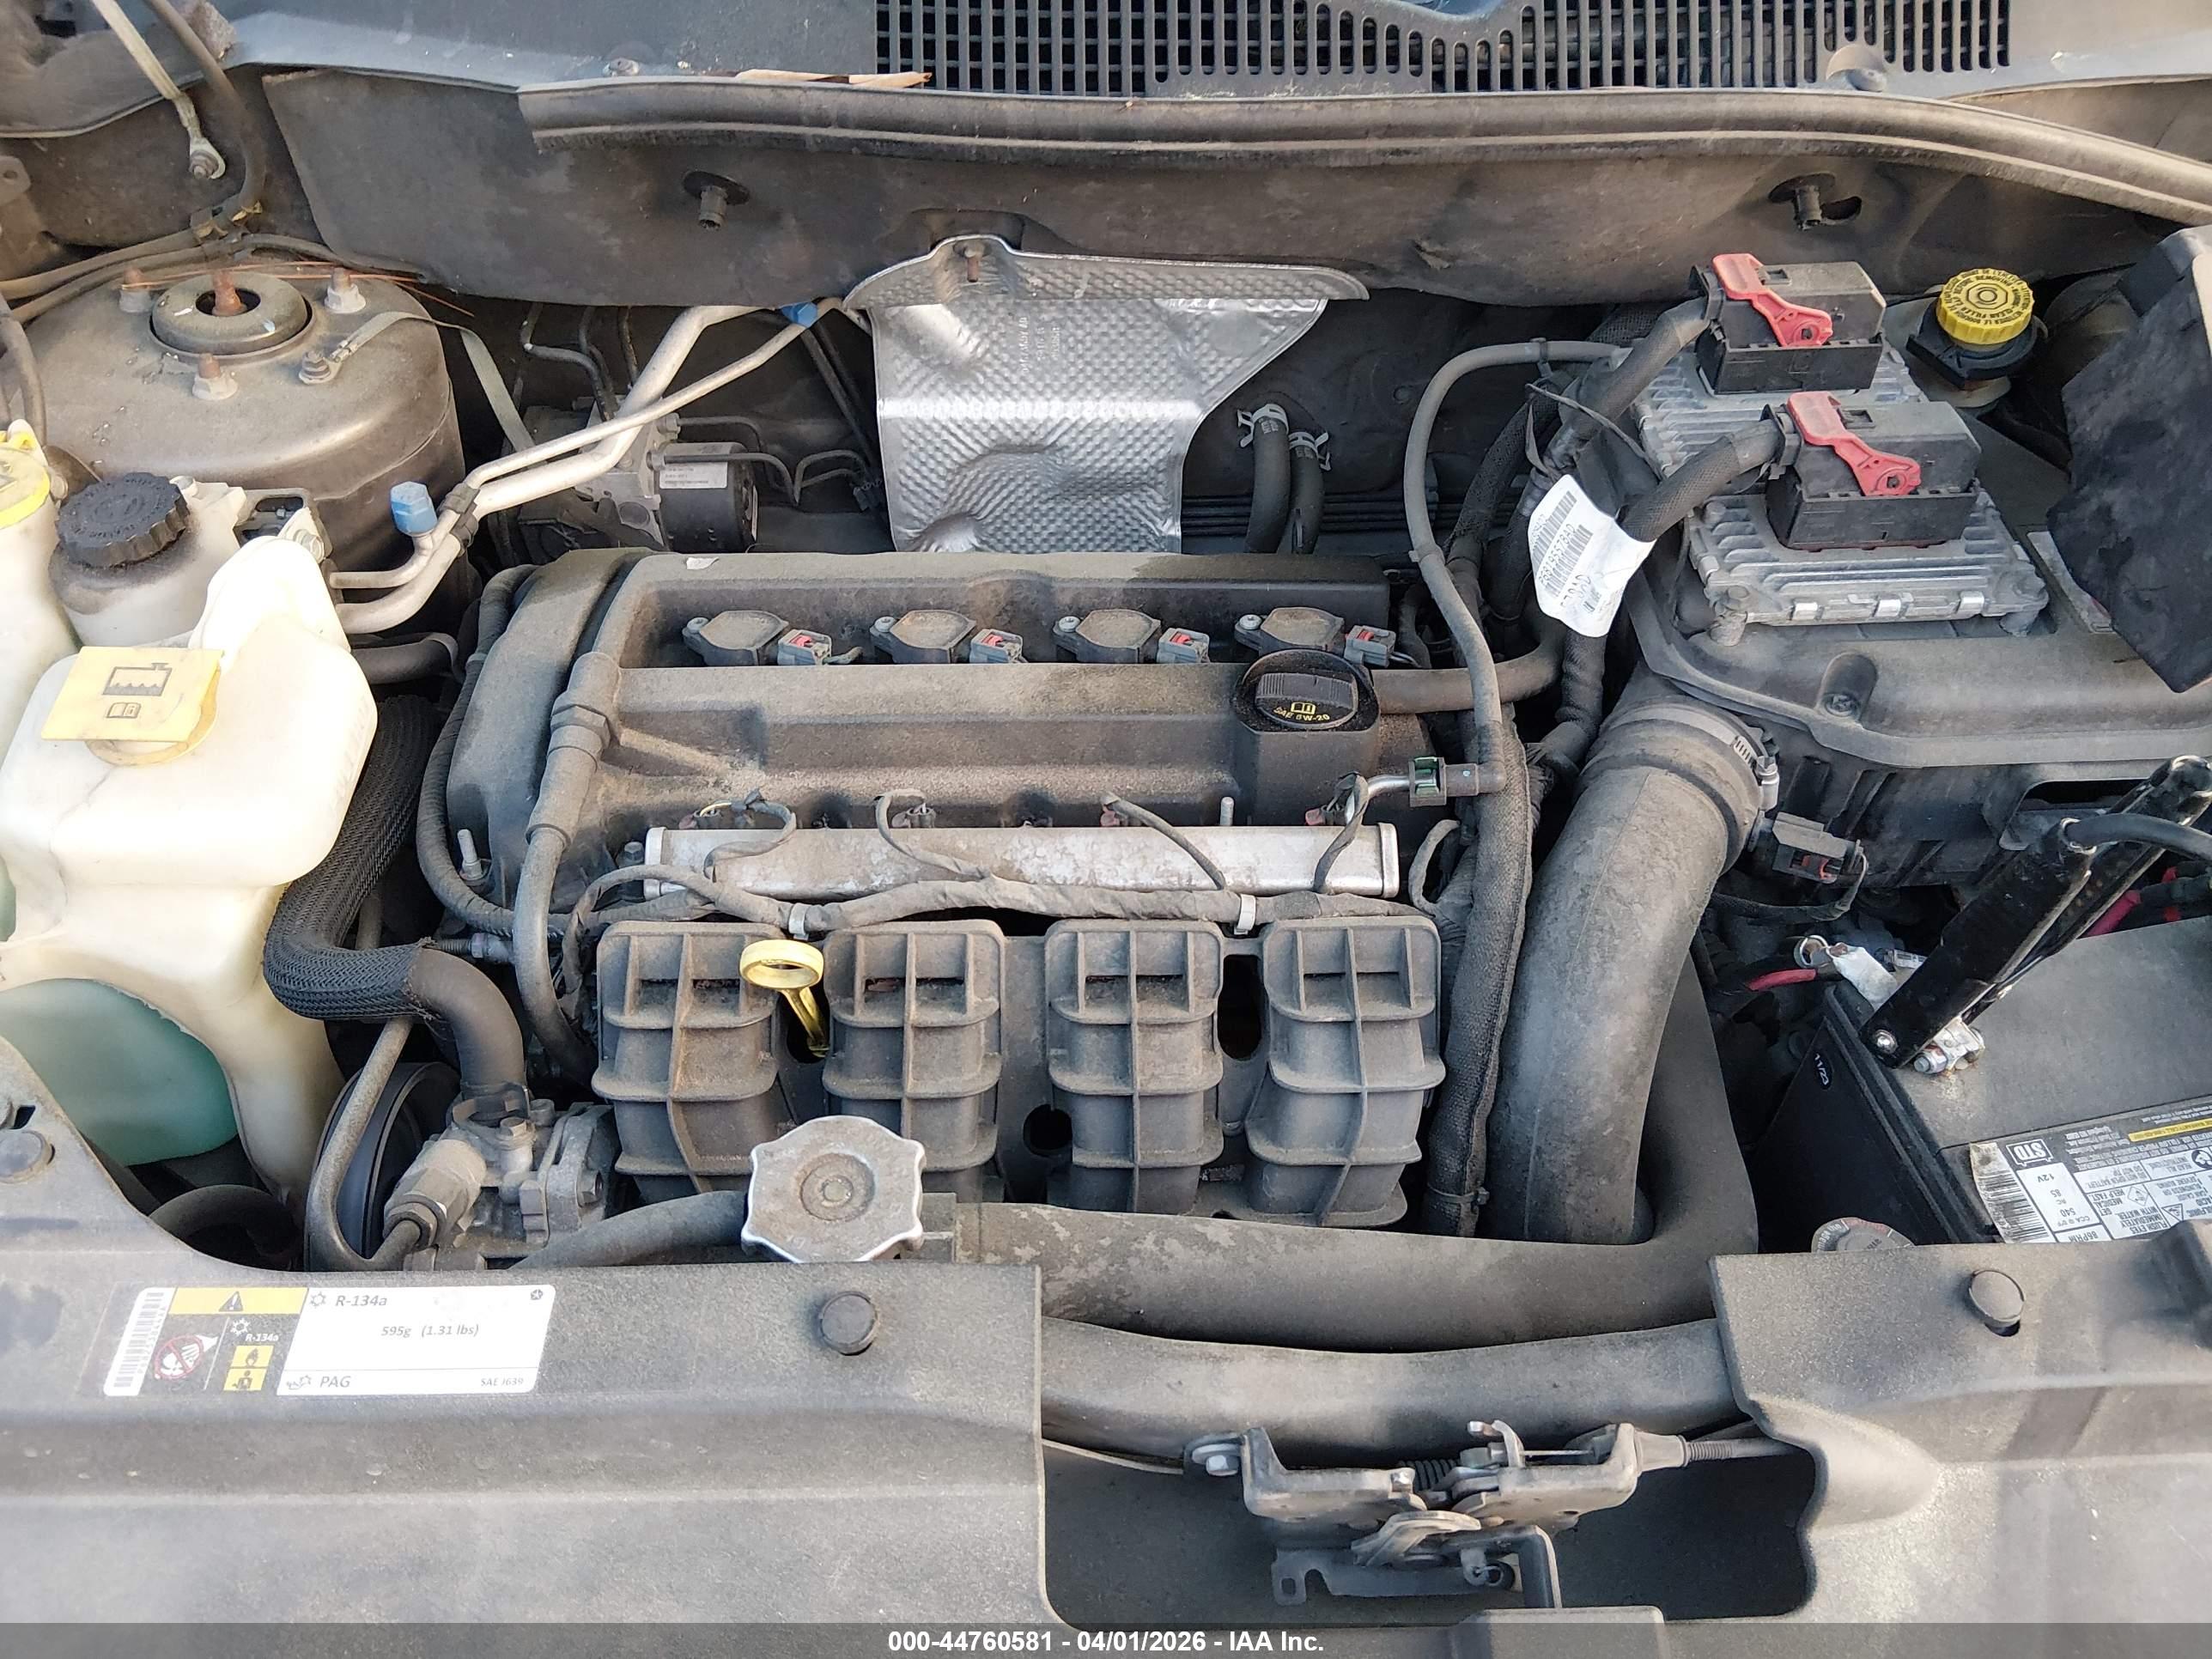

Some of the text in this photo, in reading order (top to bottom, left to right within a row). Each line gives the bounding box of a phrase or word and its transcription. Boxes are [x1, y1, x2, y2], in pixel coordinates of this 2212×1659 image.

[2013, 1142, 2047, 1161] STD
[2037, 1173, 2055, 1182] 12V
[2050, 1188, 2062, 1198] 85
[2060, 1207, 2076, 1218] 540
[2139, 1206, 2159, 1216] WITH
[2119, 1212, 2164, 1228] IMMEDIATELY
[2130, 1220, 2168, 1234] FLUSH EYES
[335, 1294, 387, 1307] R-134a
[245, 1333, 279, 1342] R-134a
[380, 1323, 479, 1339] 595g (1.31 lbs)
[319, 1376, 351, 1389] PAG
